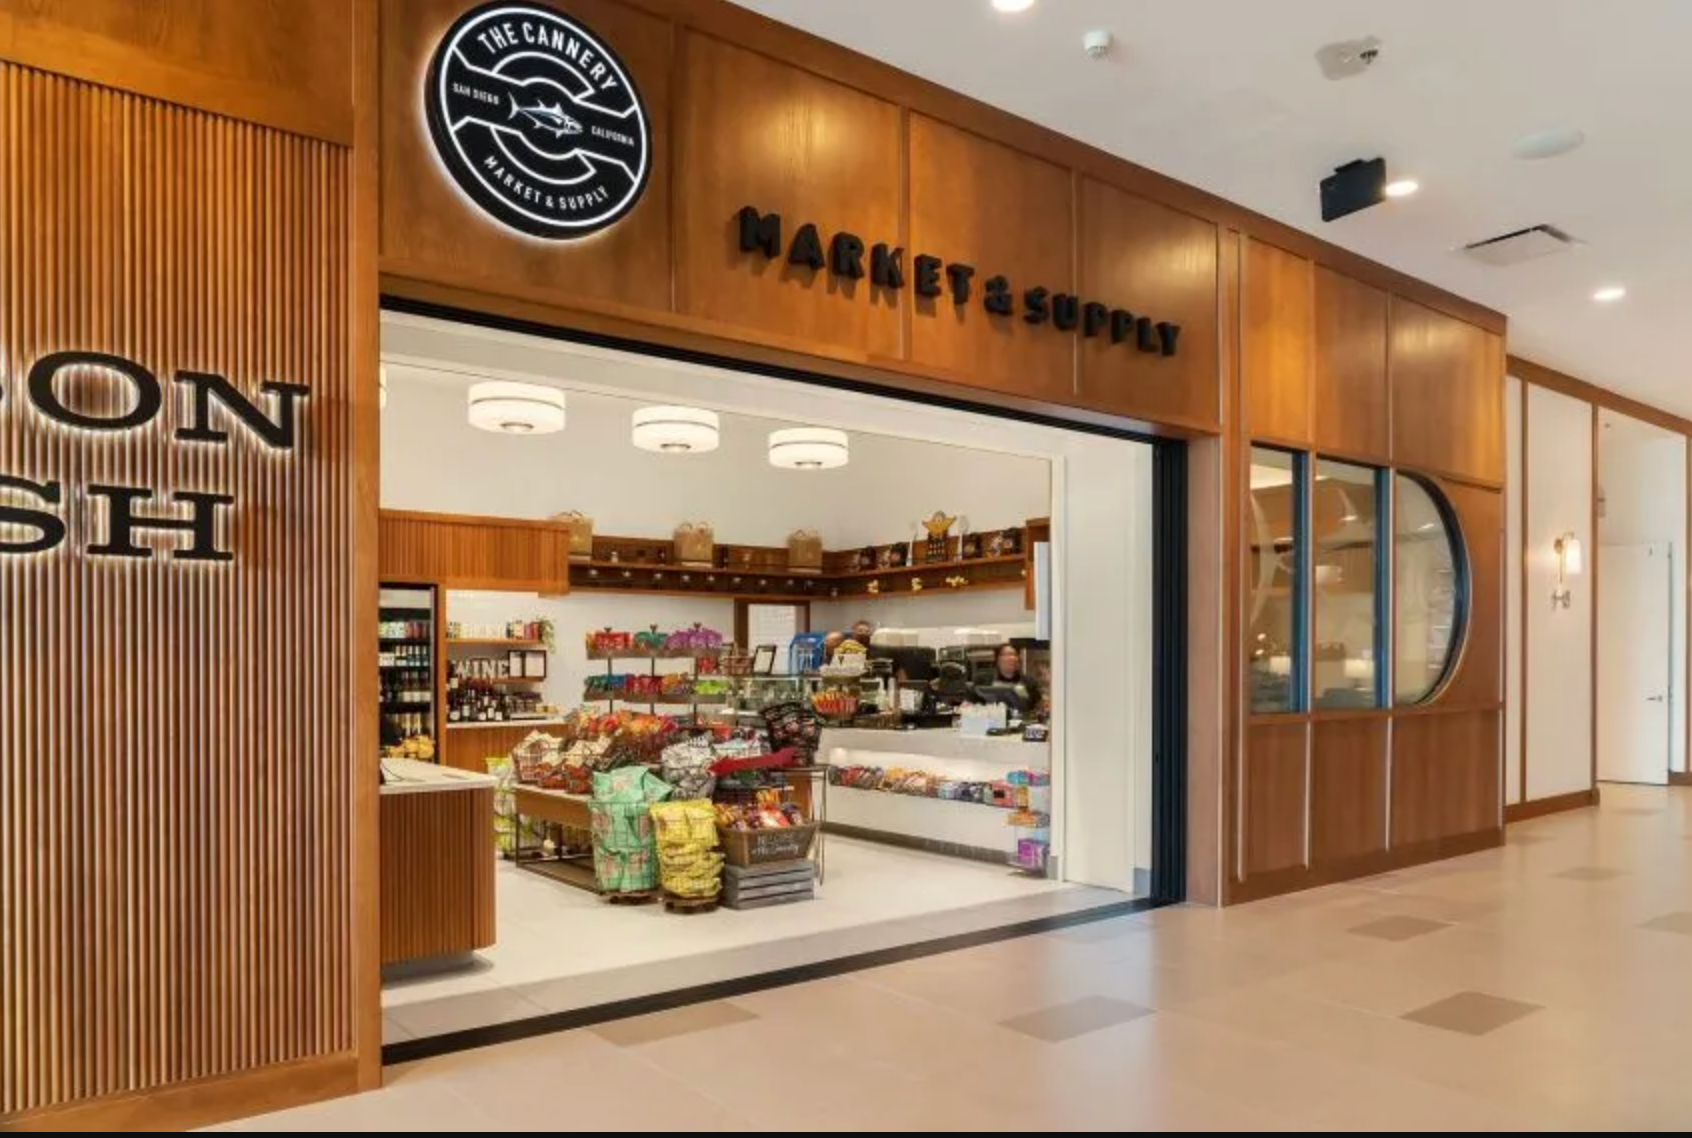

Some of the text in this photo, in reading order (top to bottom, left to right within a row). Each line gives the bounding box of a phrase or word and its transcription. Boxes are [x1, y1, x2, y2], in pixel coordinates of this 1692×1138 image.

[477, 21, 618, 91] THE CANNERY
[452, 82, 499, 105] SAN DIEGO
[591, 125, 635, 147] CALIFORNIA
[484, 155, 608, 210] MARKET & SUPPLY
[738, 205, 1181, 356] MARKET & SUPPLY
[0, 351, 310, 450] ON
[451, 658, 509, 680] WINE
